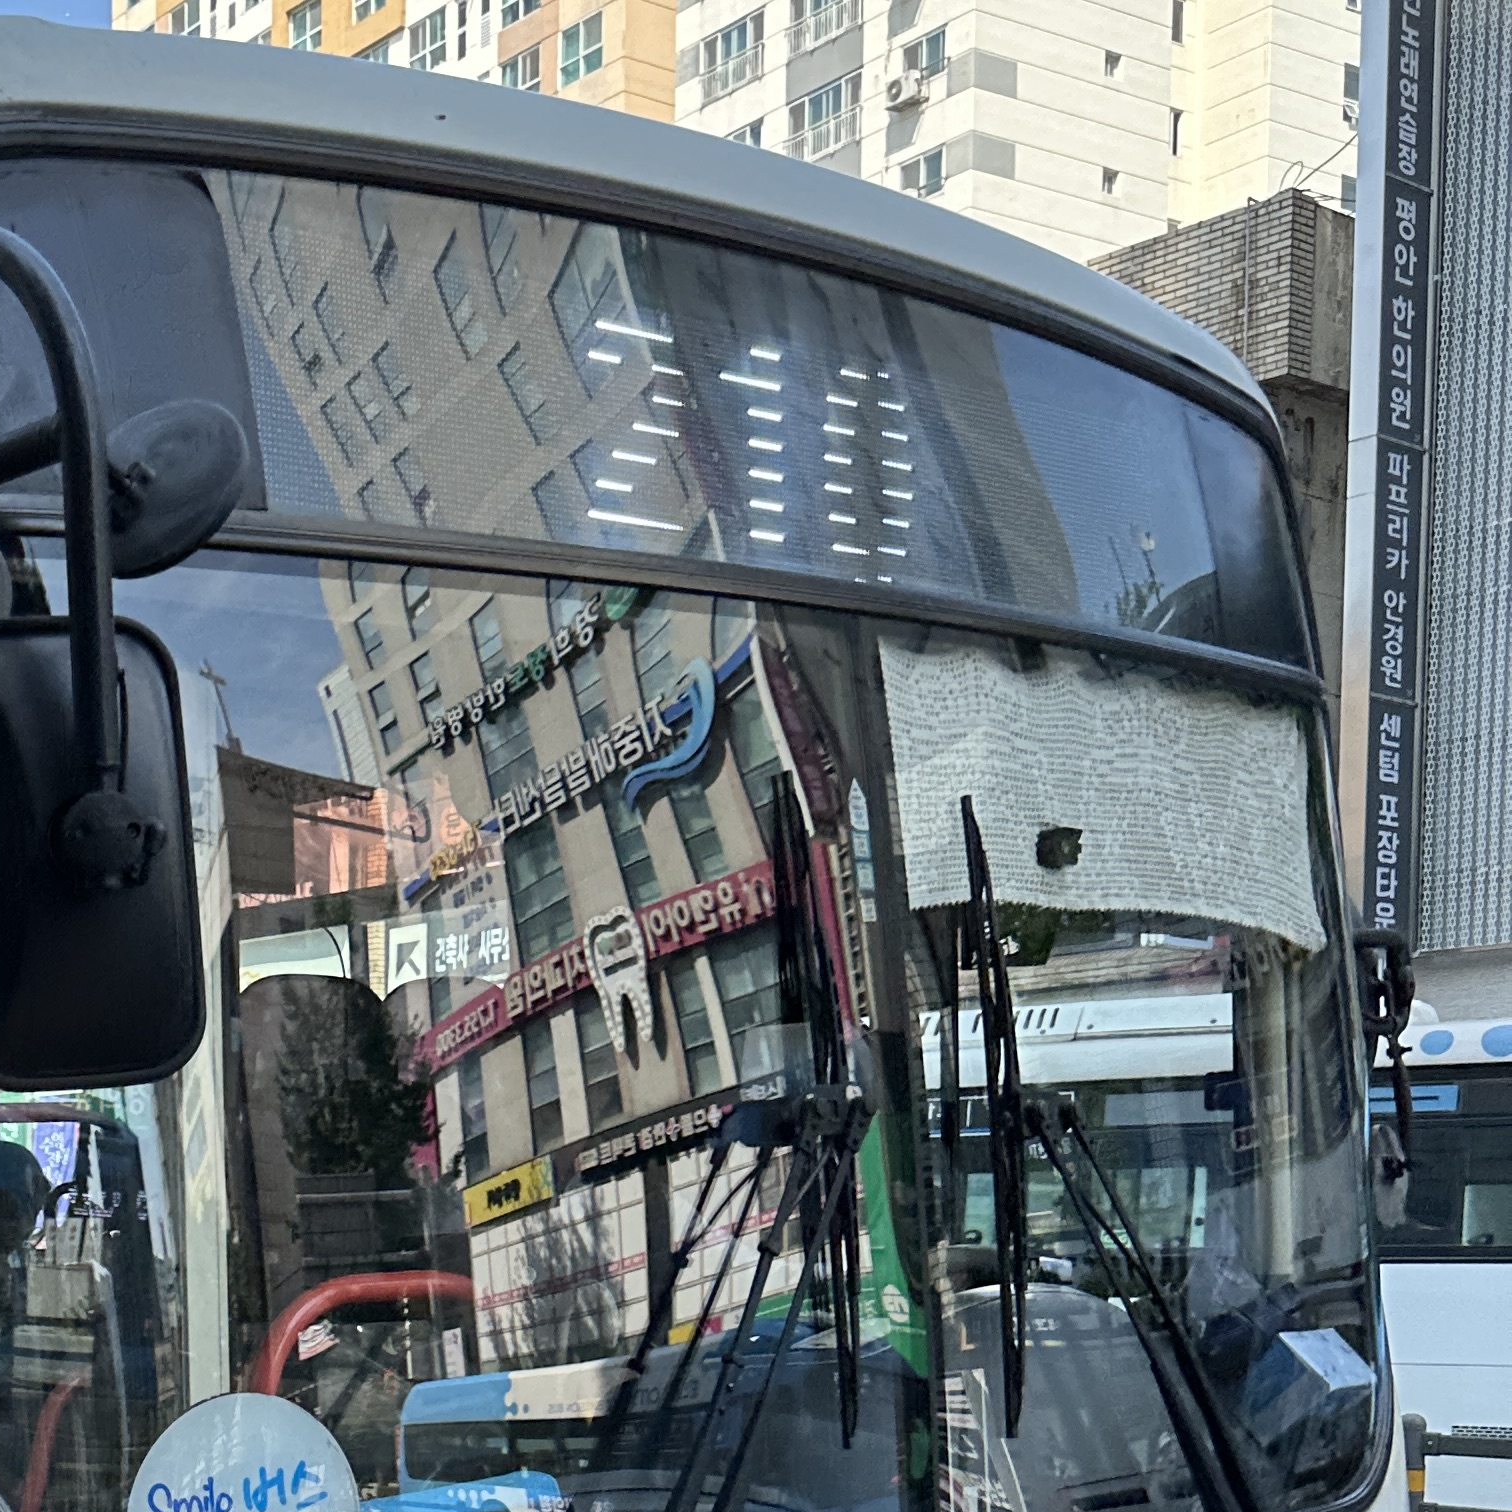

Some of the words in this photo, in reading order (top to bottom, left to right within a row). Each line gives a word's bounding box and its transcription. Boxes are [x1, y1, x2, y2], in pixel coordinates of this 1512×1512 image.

[1393, 196, 1417, 287] 평안
[1387, 294, 1414, 432] 한의원
[588, 320, 915, 583] 210
[1383, 451, 1412, 580] 파프리카
[1379, 589, 1406, 689] 안경원
[1377, 714, 1403, 784] 센텀
[243, 1460, 328, 1512] 버스
